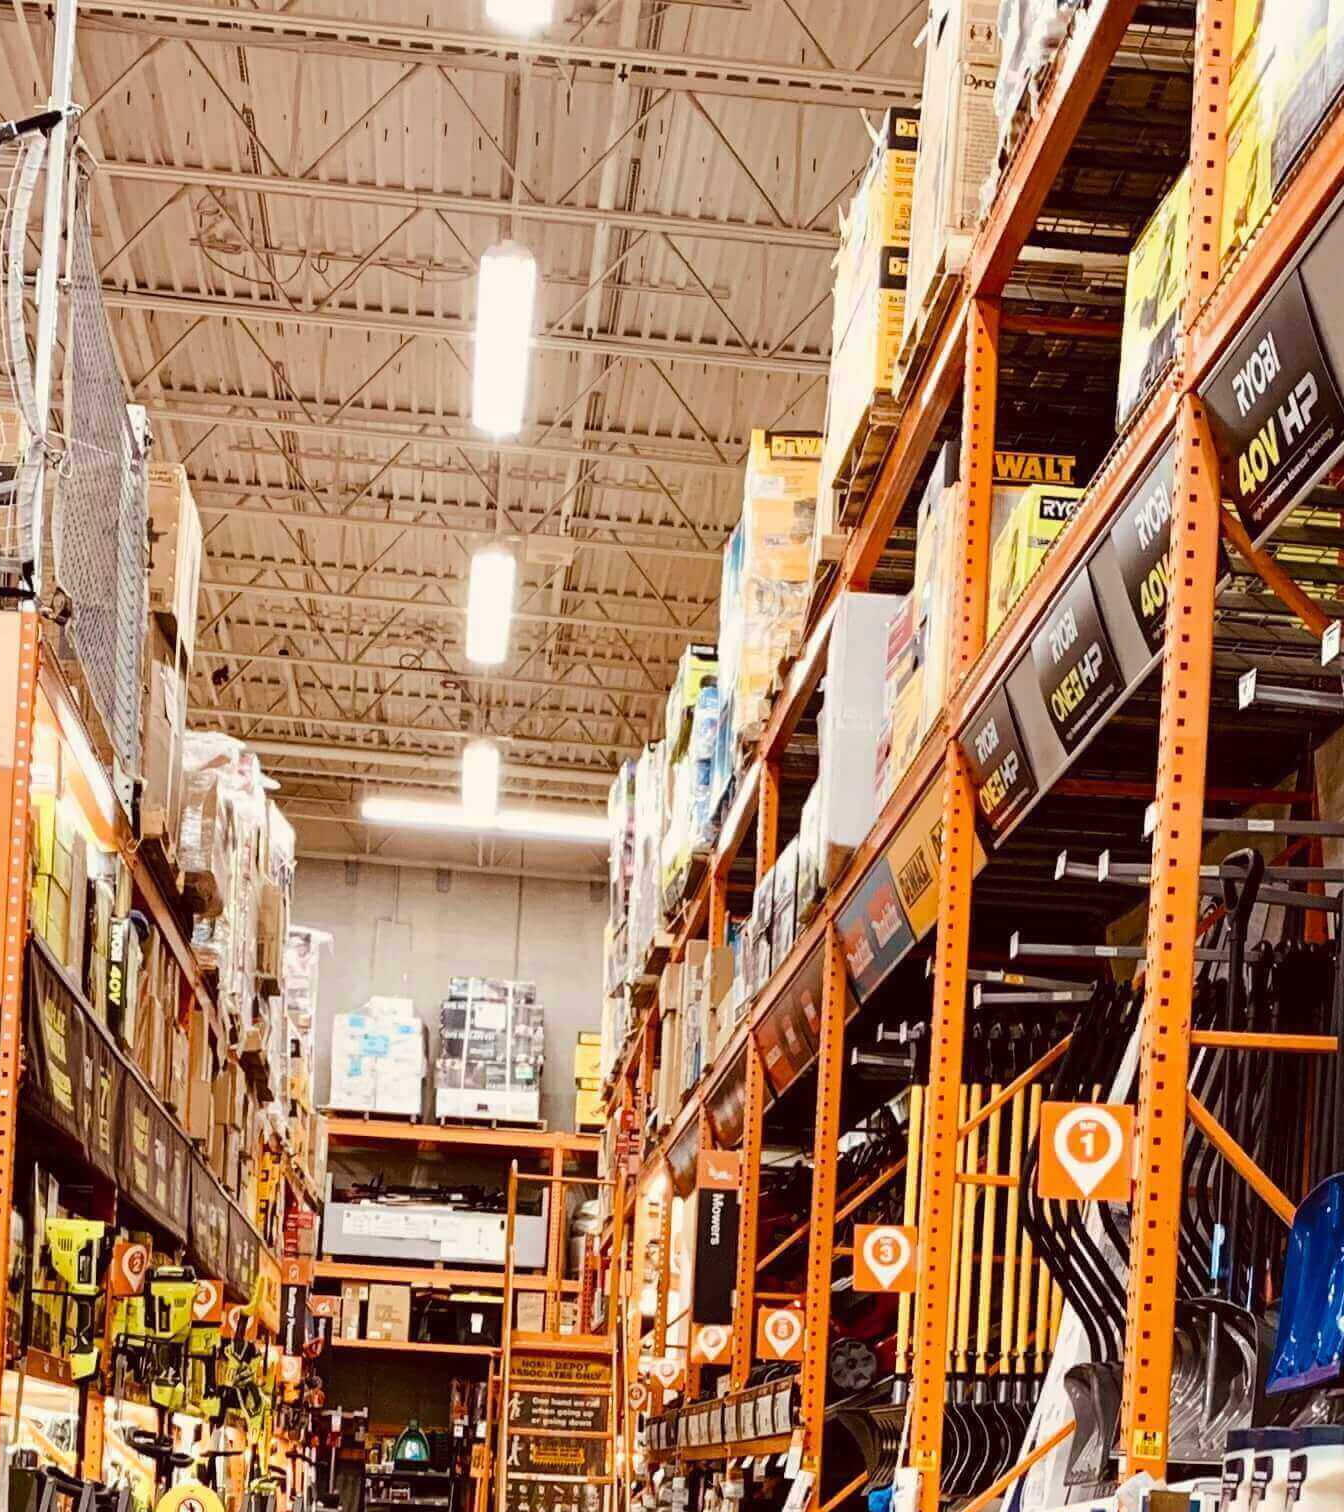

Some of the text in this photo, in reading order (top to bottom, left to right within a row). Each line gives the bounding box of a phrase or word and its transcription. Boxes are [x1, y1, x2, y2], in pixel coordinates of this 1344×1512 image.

[1231, 331, 1281, 417] RYOBI
[1238, 371, 1318, 496] 40V HP
[993, 455, 1076, 481] WALT
[1048, 607, 1078, 665] RYOBI
[1077, 641, 1103, 689] HP
[975, 717, 999, 765] RYOBI
[999, 750, 1019, 789] HP
[107, 964, 122, 1005] 40V
[1078, 1132, 1094, 1158] 1
[710, 1193, 725, 1246] Mowers
[879, 1243, 894, 1262] 3
[576, 1372, 602, 1380] ONLY
[532, 1407, 555, 1415] when
[557, 1409, 581, 1420] going
[551, 1397, 572, 1407] hand
[542, 1418, 567, 1426] going
